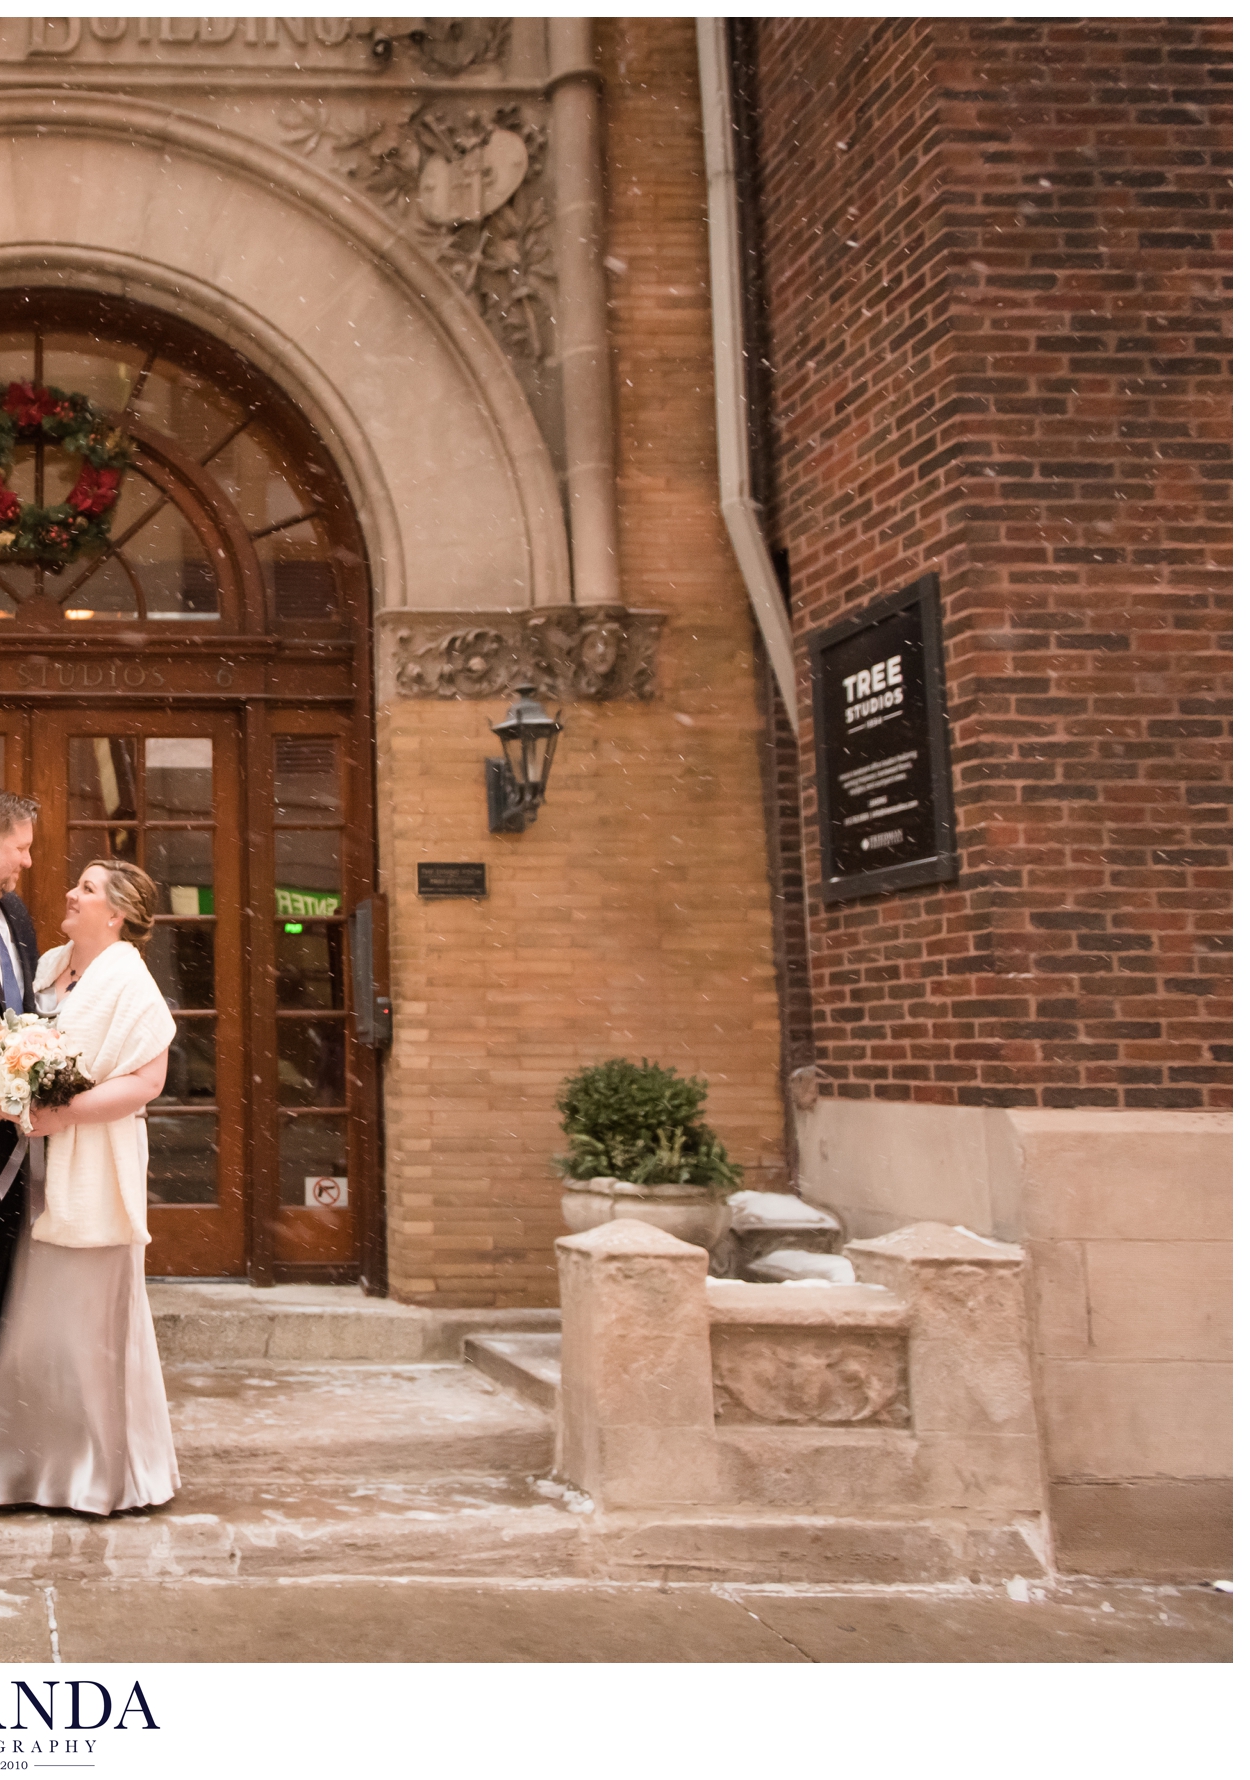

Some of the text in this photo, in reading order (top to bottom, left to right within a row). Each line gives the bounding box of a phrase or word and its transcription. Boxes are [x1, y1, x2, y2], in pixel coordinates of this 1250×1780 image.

[18, 663, 166, 688] STUDIOS
[216, 665, 233, 688] 6
[842, 654, 903, 703] TREE
[845, 687, 904, 724] STUDIOS
